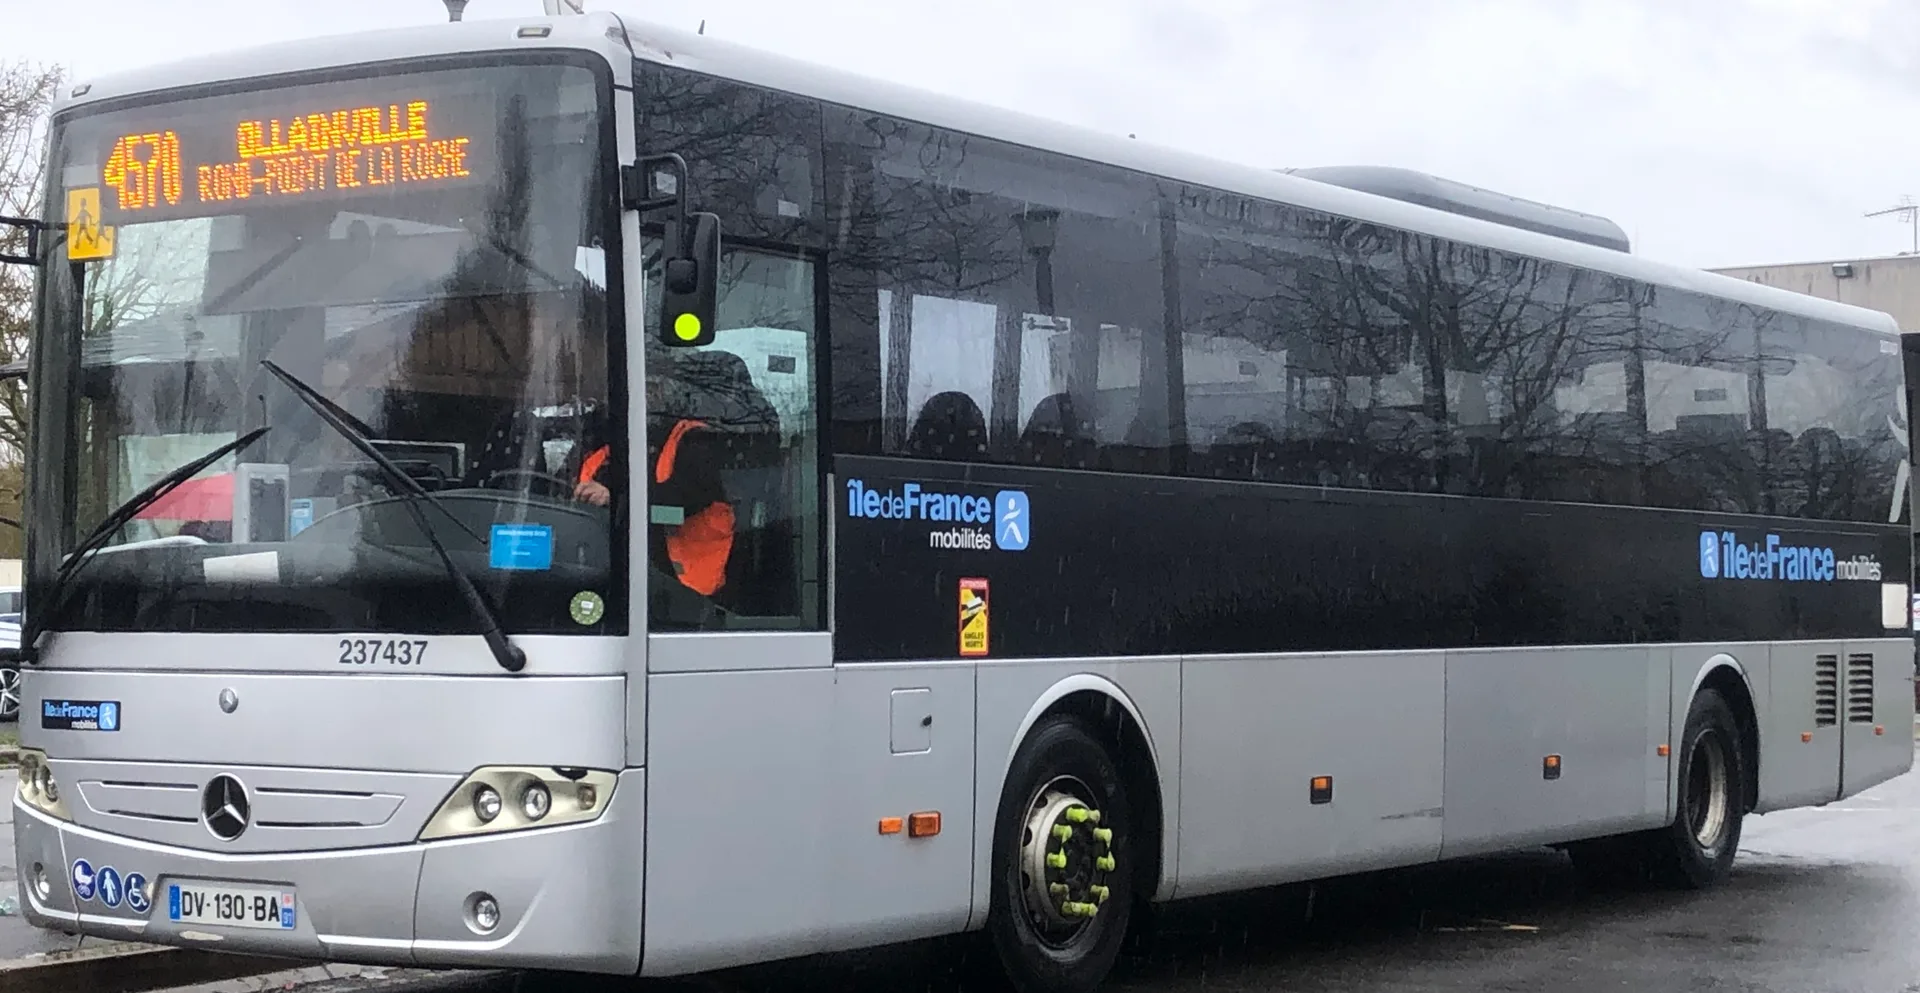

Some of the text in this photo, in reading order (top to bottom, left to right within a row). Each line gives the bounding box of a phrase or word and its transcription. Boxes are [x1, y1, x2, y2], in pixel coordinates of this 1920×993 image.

[236, 101, 428, 158] OLLAINVILLE
[105, 131, 182, 210] 4570
[336, 150, 361, 188] DE
[368, 146, 394, 184] LA
[401, 138, 470, 181] ROCHE
[930, 528, 991, 549] mobilités
[1837, 554, 1881, 580] mobilités
[339, 640, 428, 665] 237437
